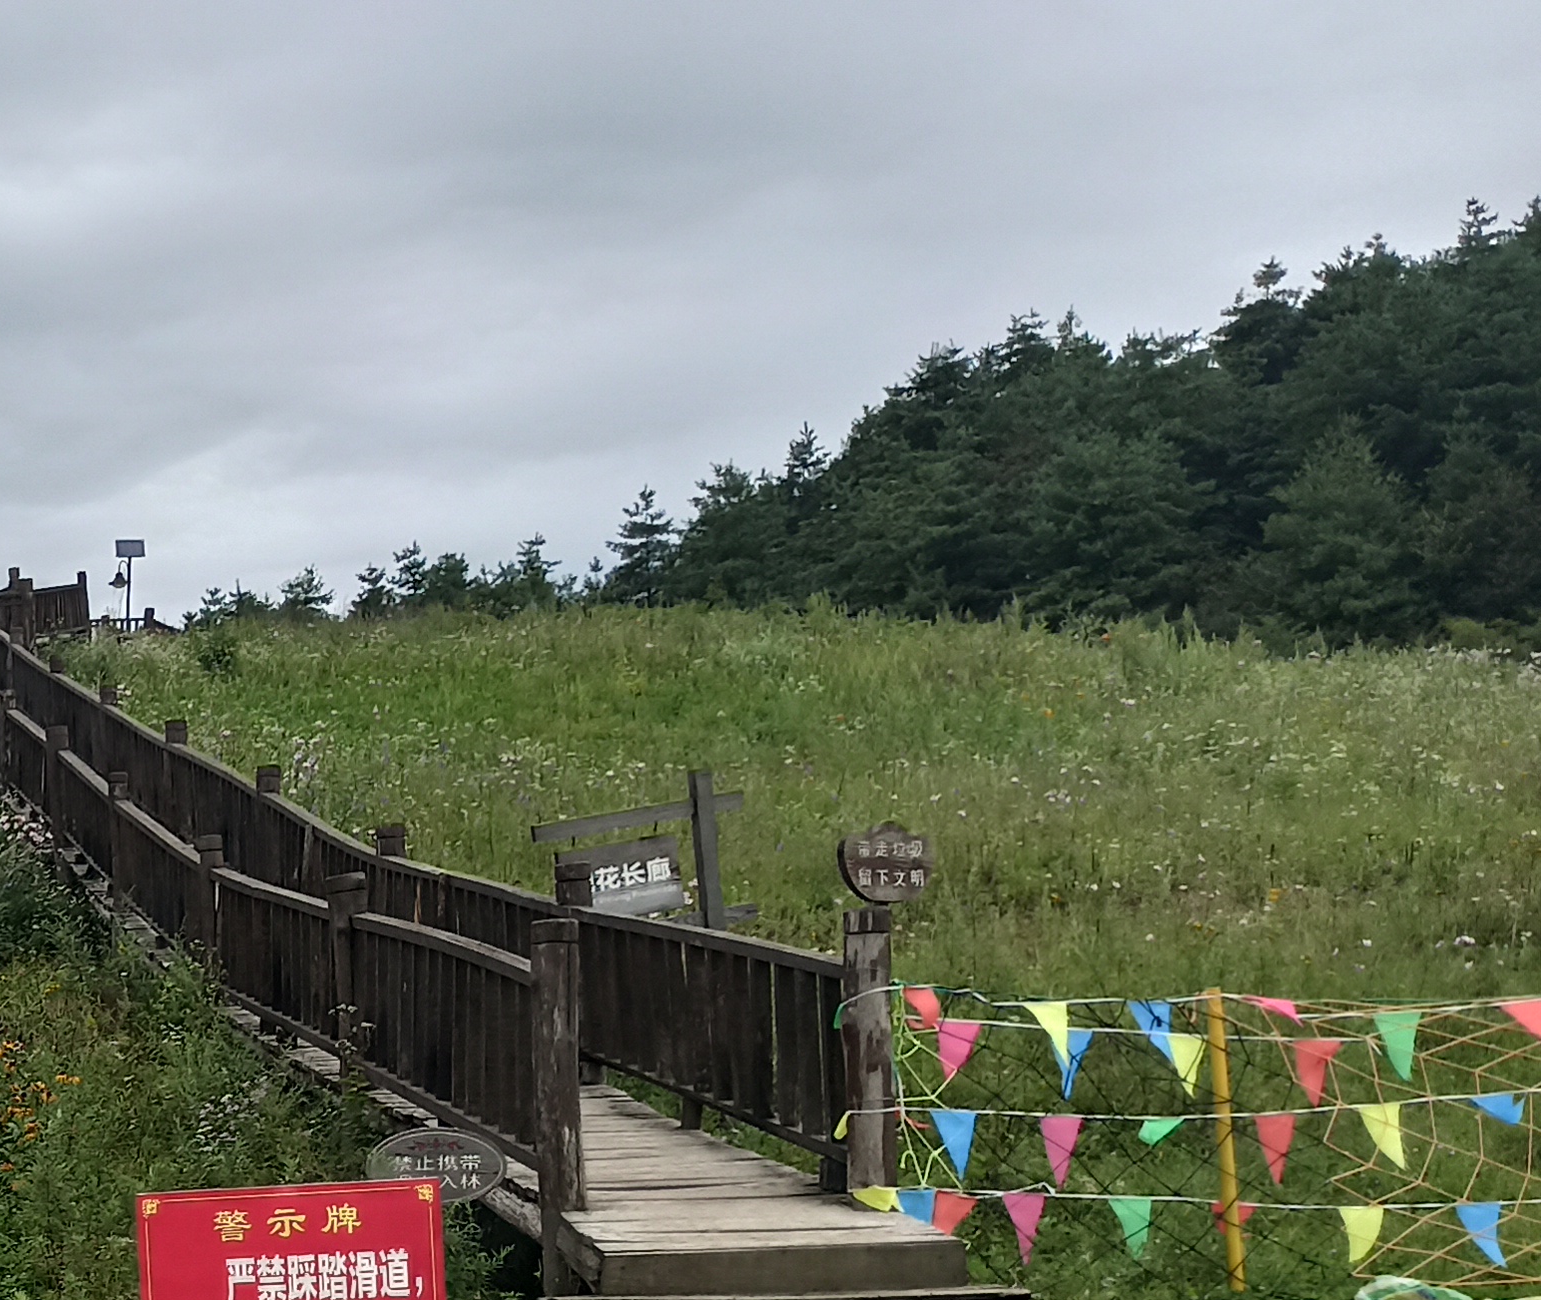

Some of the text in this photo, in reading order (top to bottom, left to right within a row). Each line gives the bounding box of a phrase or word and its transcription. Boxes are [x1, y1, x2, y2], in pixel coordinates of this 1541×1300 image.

[858, 841, 923, 858] 带走垃圾
[589, 857, 671, 893] 花长廊
[858, 868, 924, 887] 留下文明
[392, 1154, 481, 1172] 禁止携带
[213, 1203, 362, 1242] 警示牌
